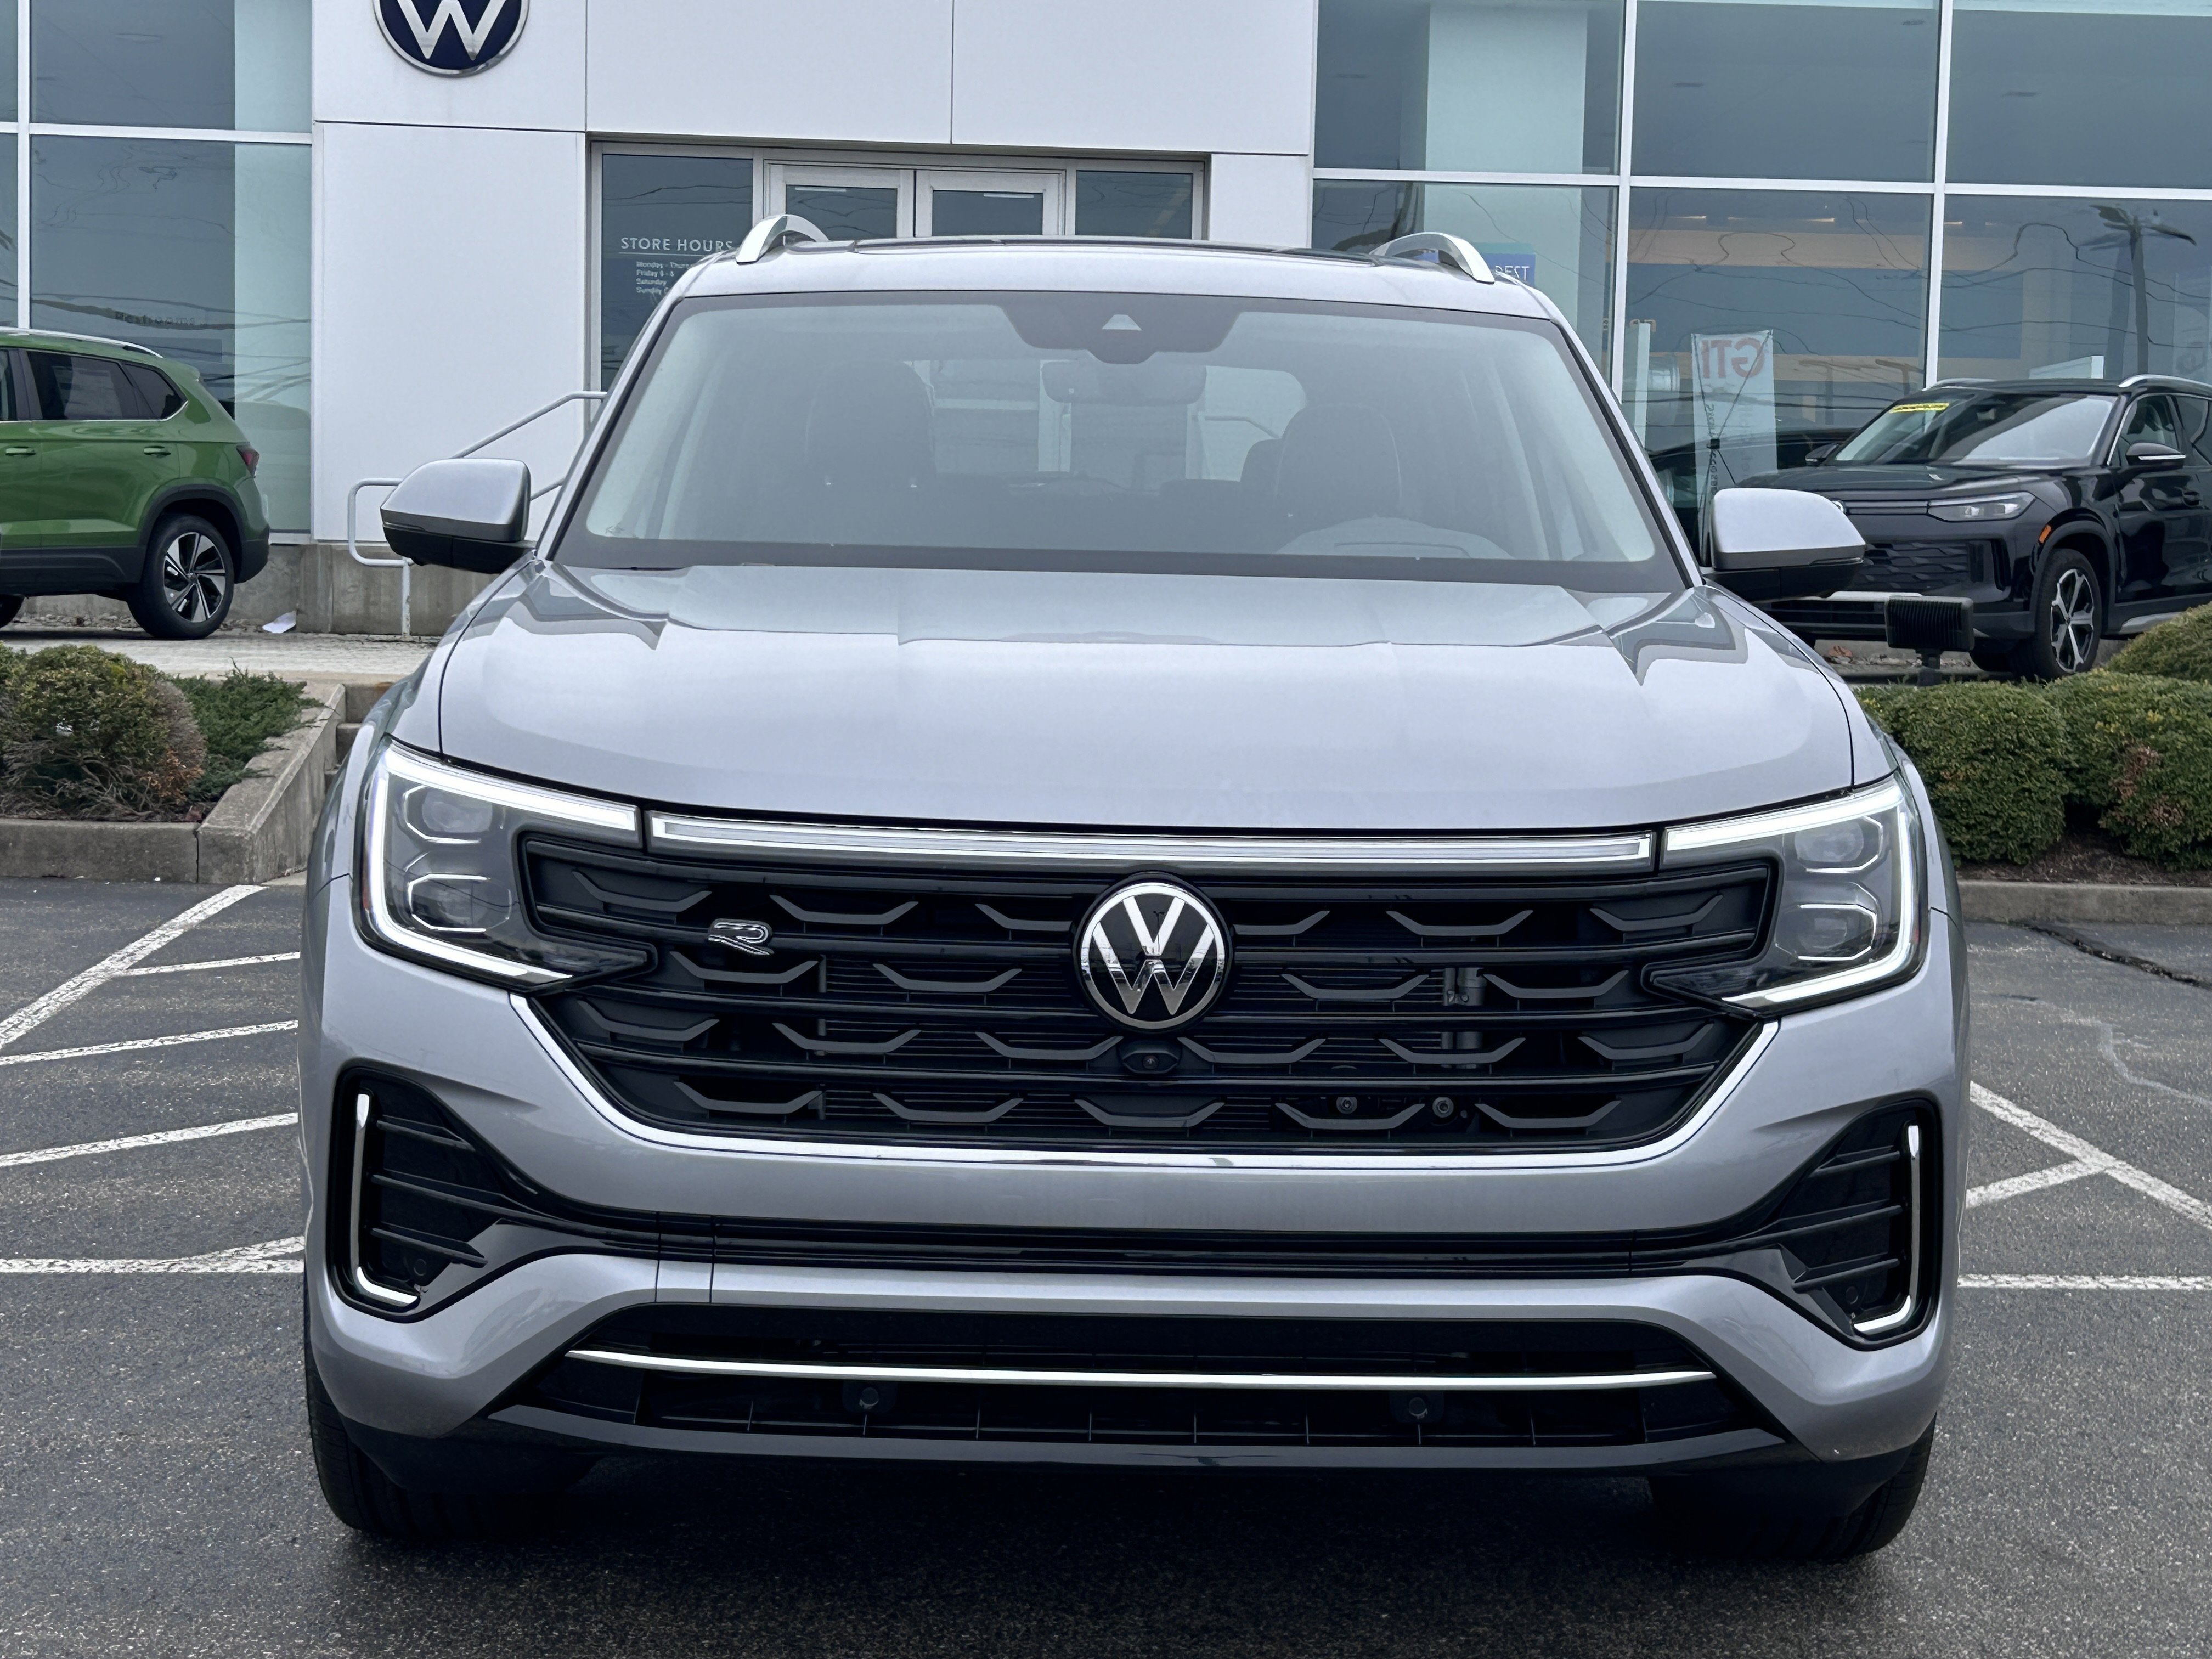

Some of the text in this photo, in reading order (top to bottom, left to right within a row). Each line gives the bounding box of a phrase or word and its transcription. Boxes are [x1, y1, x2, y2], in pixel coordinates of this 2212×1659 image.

[621, 237, 670, 251] STORE
[636, 278, 667, 286] Saturday
[636, 286, 662, 295] Sunday
